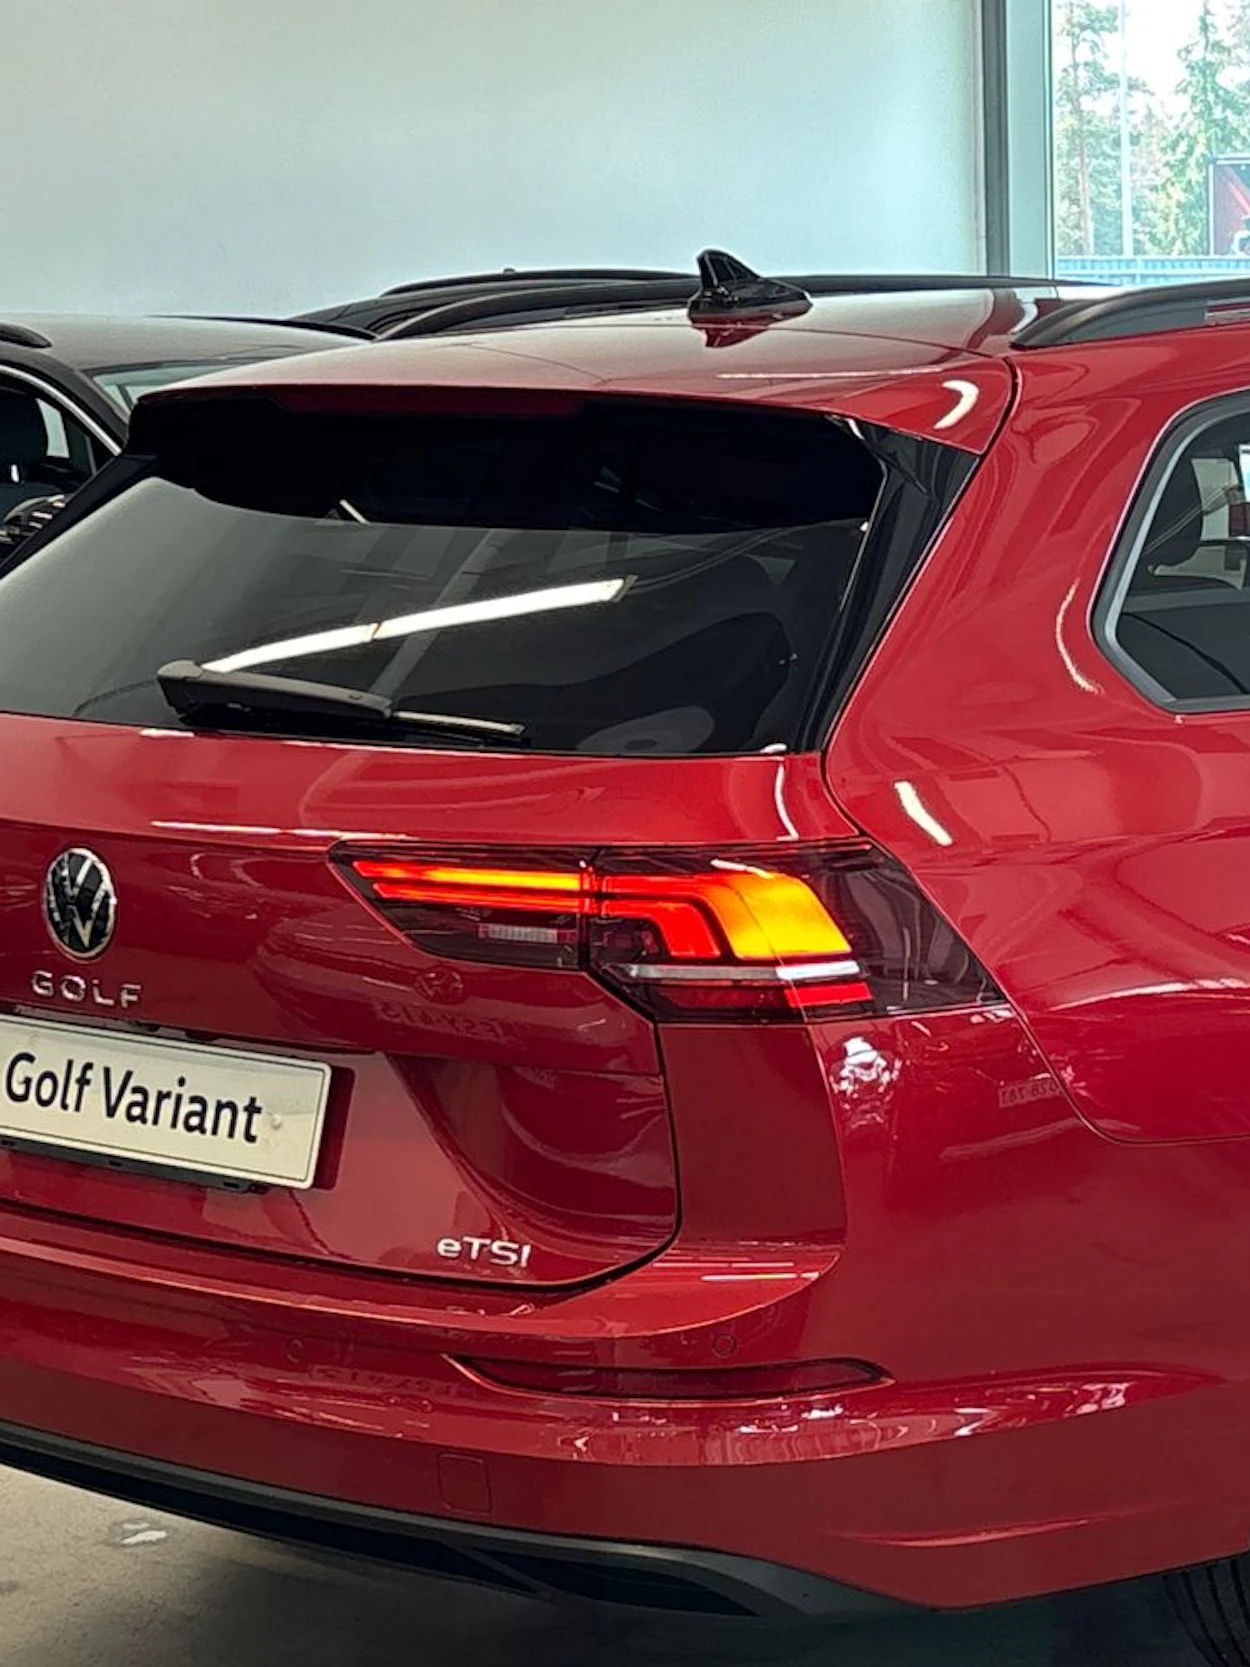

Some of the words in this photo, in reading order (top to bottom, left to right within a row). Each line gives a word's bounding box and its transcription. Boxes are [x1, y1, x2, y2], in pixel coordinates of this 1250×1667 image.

[31, 969, 142, 1008] GOLF
[5, 1052, 94, 1112] Golf
[103, 1067, 263, 1143] Variant
[437, 1236, 531, 1268] eTSI
